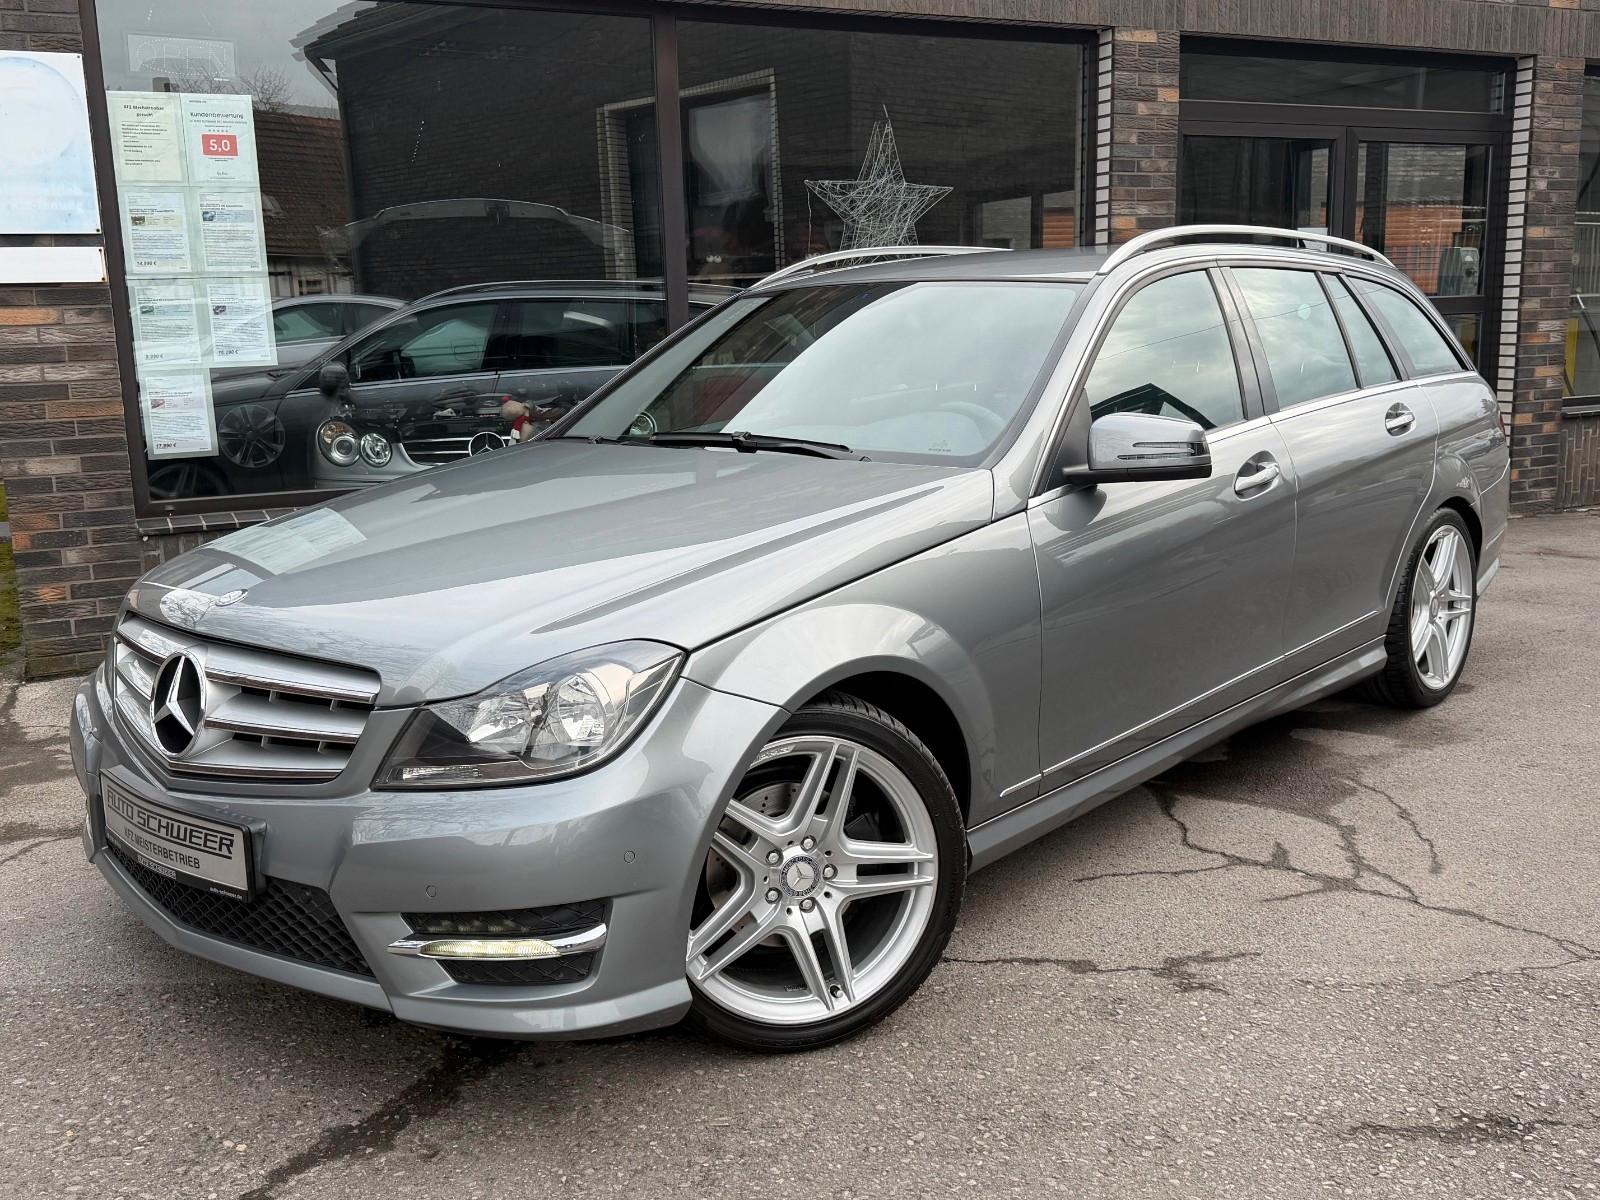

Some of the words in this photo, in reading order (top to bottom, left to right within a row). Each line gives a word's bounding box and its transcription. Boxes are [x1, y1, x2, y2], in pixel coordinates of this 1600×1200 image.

[209, 139, 231, 152] 5,0
[107, 789, 134, 821] AUTO
[137, 811, 235, 855] SCHWEER
[135, 833, 201, 869] MEISTERBETRIEB
